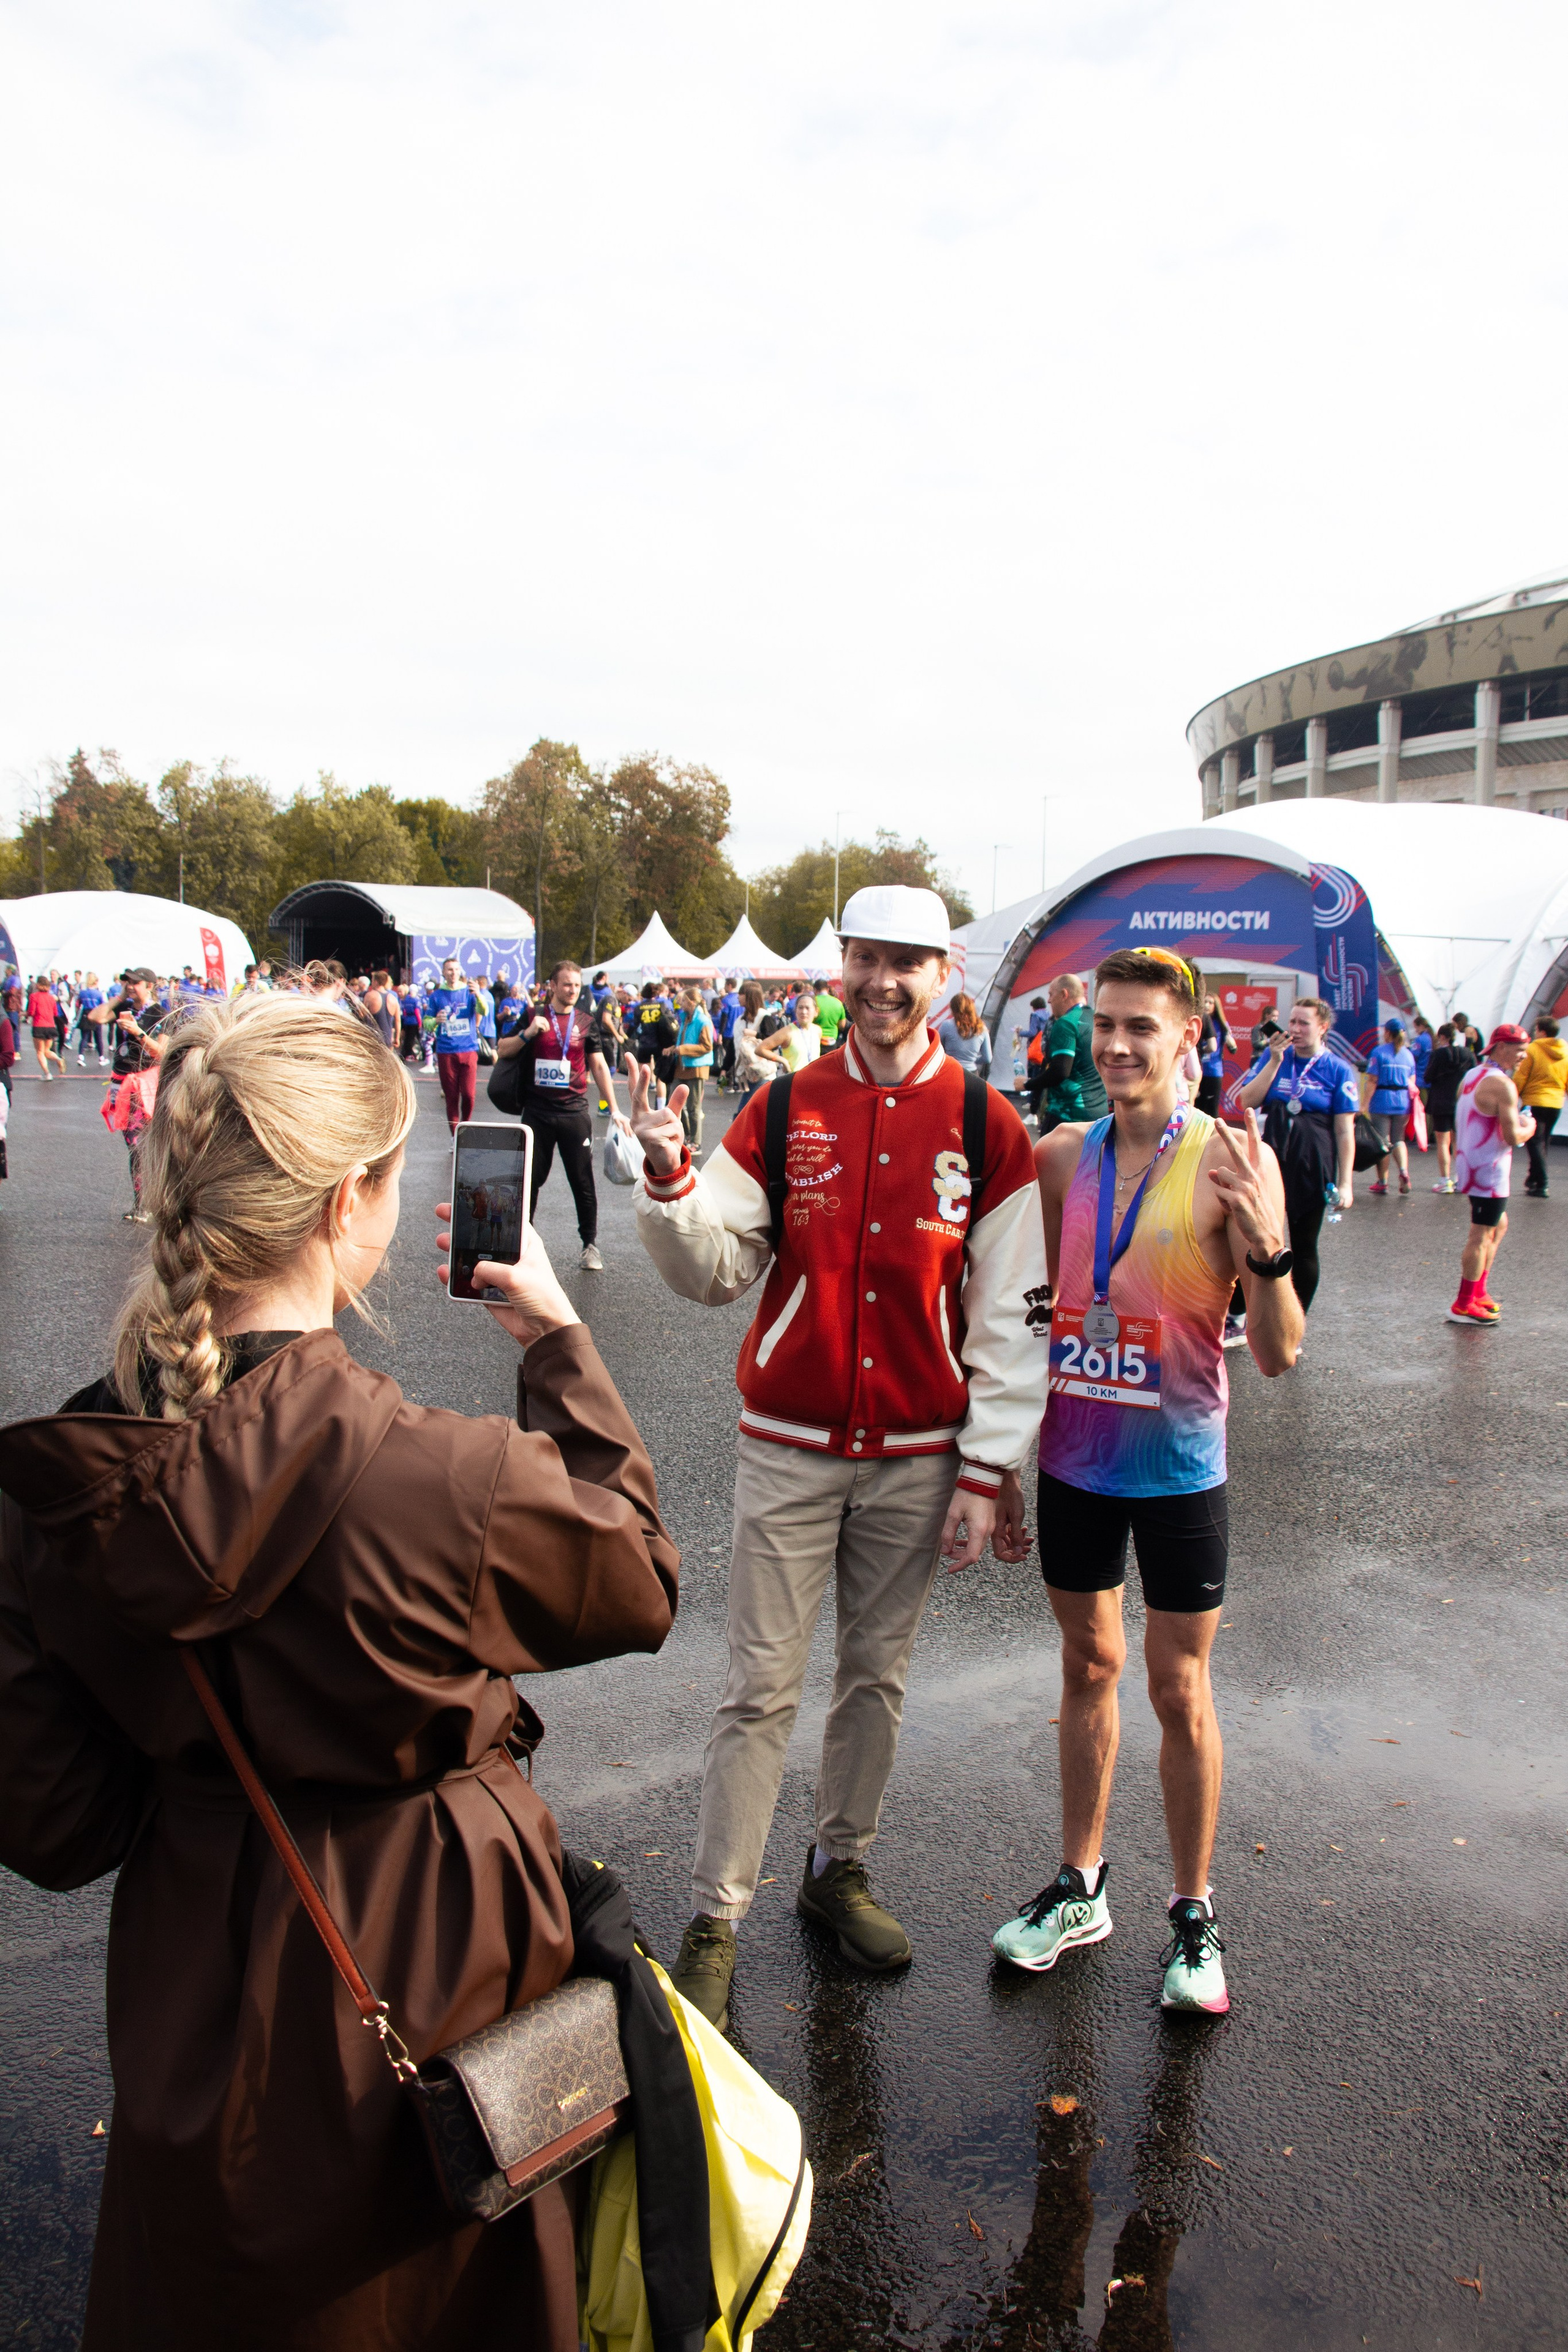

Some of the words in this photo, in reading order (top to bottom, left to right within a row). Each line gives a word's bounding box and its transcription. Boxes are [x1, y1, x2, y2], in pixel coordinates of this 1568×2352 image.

[1129, 910, 1270, 930] АКТИВНОСТИ
[801, 1131, 838, 1141] LORD
[806, 1153, 826, 1163] will
[800, 1190, 825, 1203] plans
[793, 1215, 809, 1226] 16:3
[916, 1218, 944, 1233] SOUTH
[946, 1223, 966, 1240] CARO
[1060, 1335, 1147, 1384] 2615
[1087, 1385, 1098, 1395] 10
